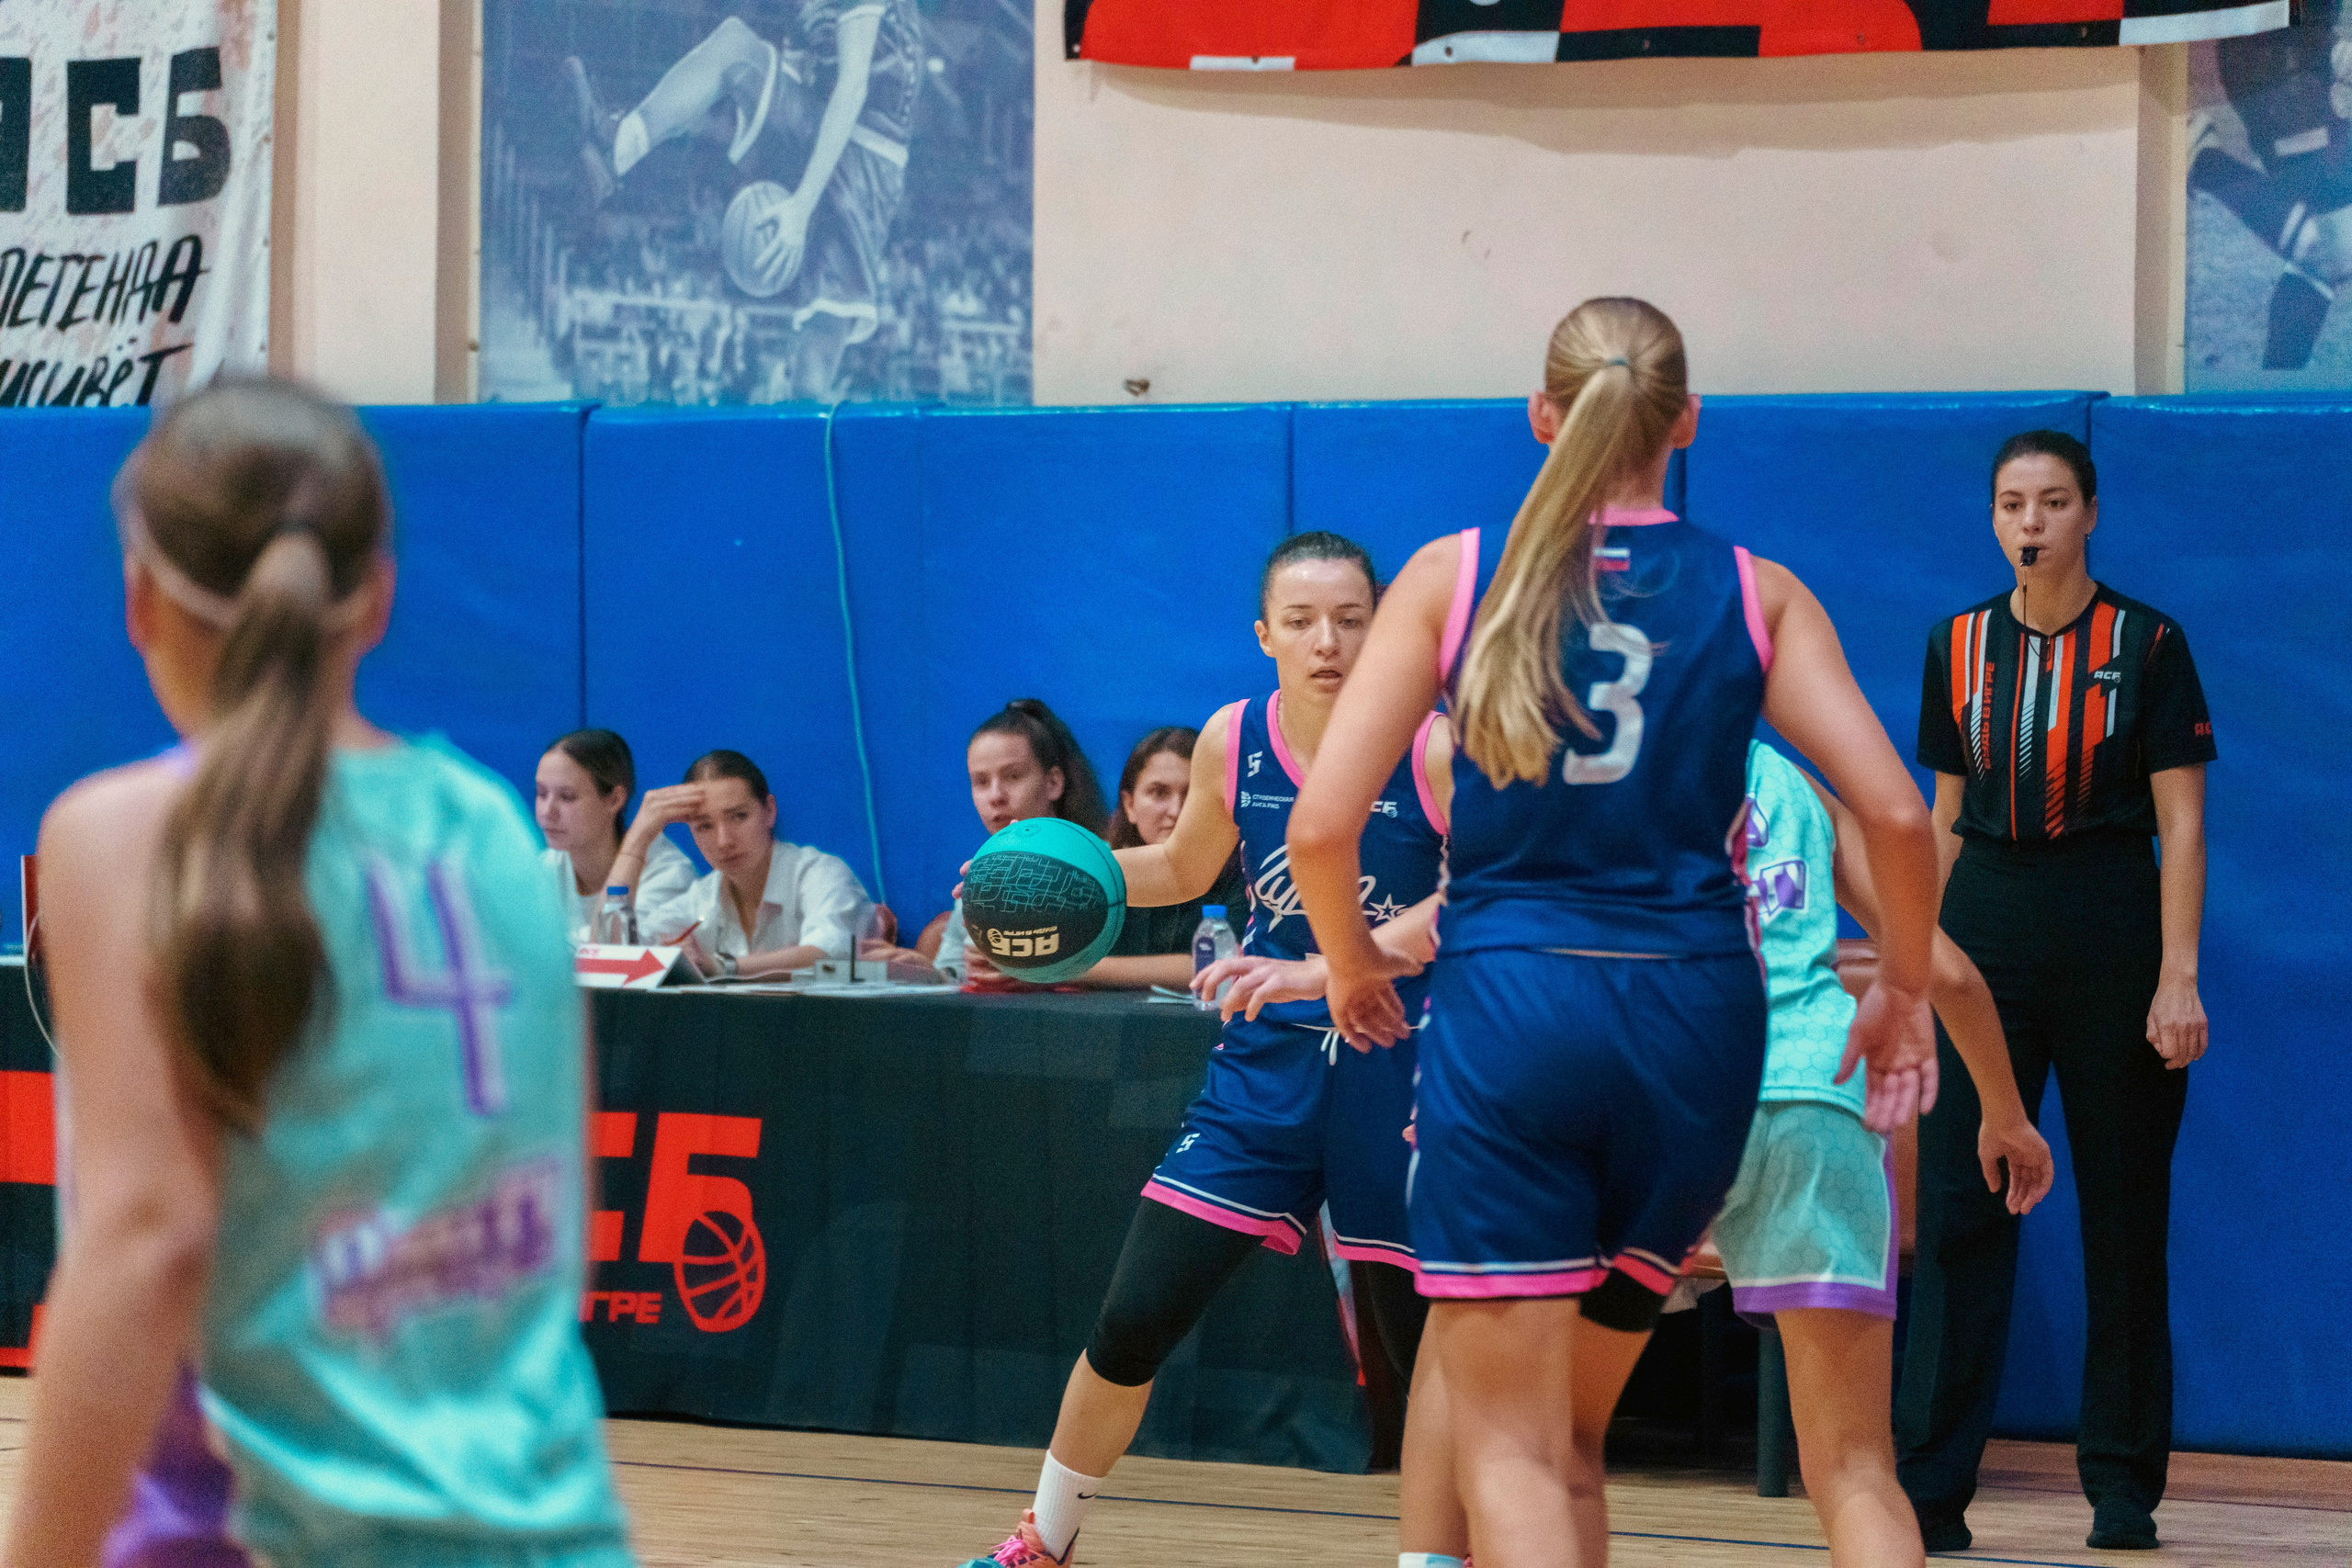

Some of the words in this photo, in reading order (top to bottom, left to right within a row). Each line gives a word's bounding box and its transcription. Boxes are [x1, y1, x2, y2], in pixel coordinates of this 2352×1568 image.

[1563, 622, 1653, 784] 3
[2195, 722, 2211, 736] АС
[1369, 800, 1398, 818] СБ
[366, 852, 514, 1115] 4
[578, 1290, 662, 1324] ГРЕ
